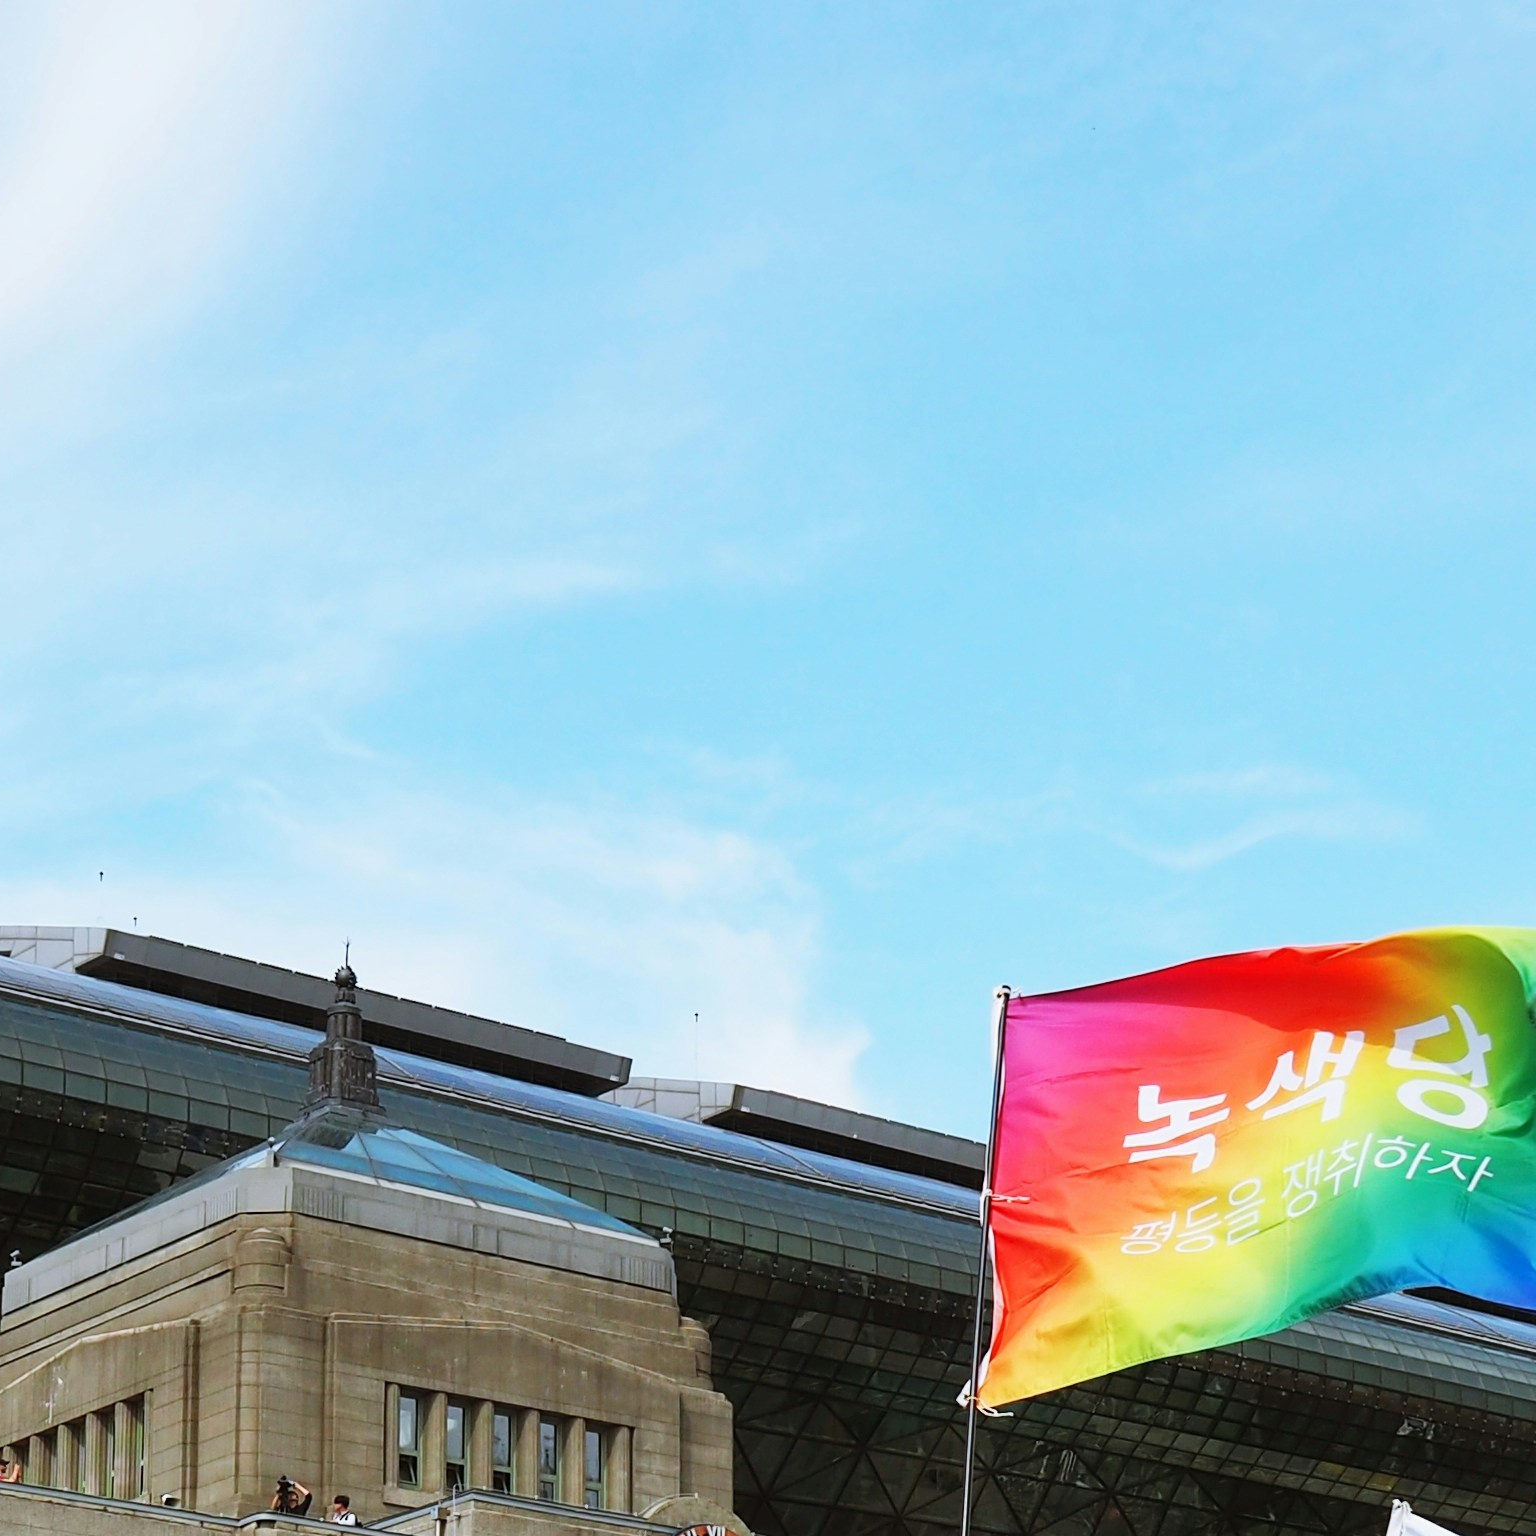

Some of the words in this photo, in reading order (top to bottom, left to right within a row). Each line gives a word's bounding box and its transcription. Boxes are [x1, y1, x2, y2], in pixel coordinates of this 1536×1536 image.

[1123, 1004, 1493, 1173] 녹색당
[1120, 1177, 1262, 1256] 평등을
[1279, 1132, 1496, 1219] 쟁취하자
